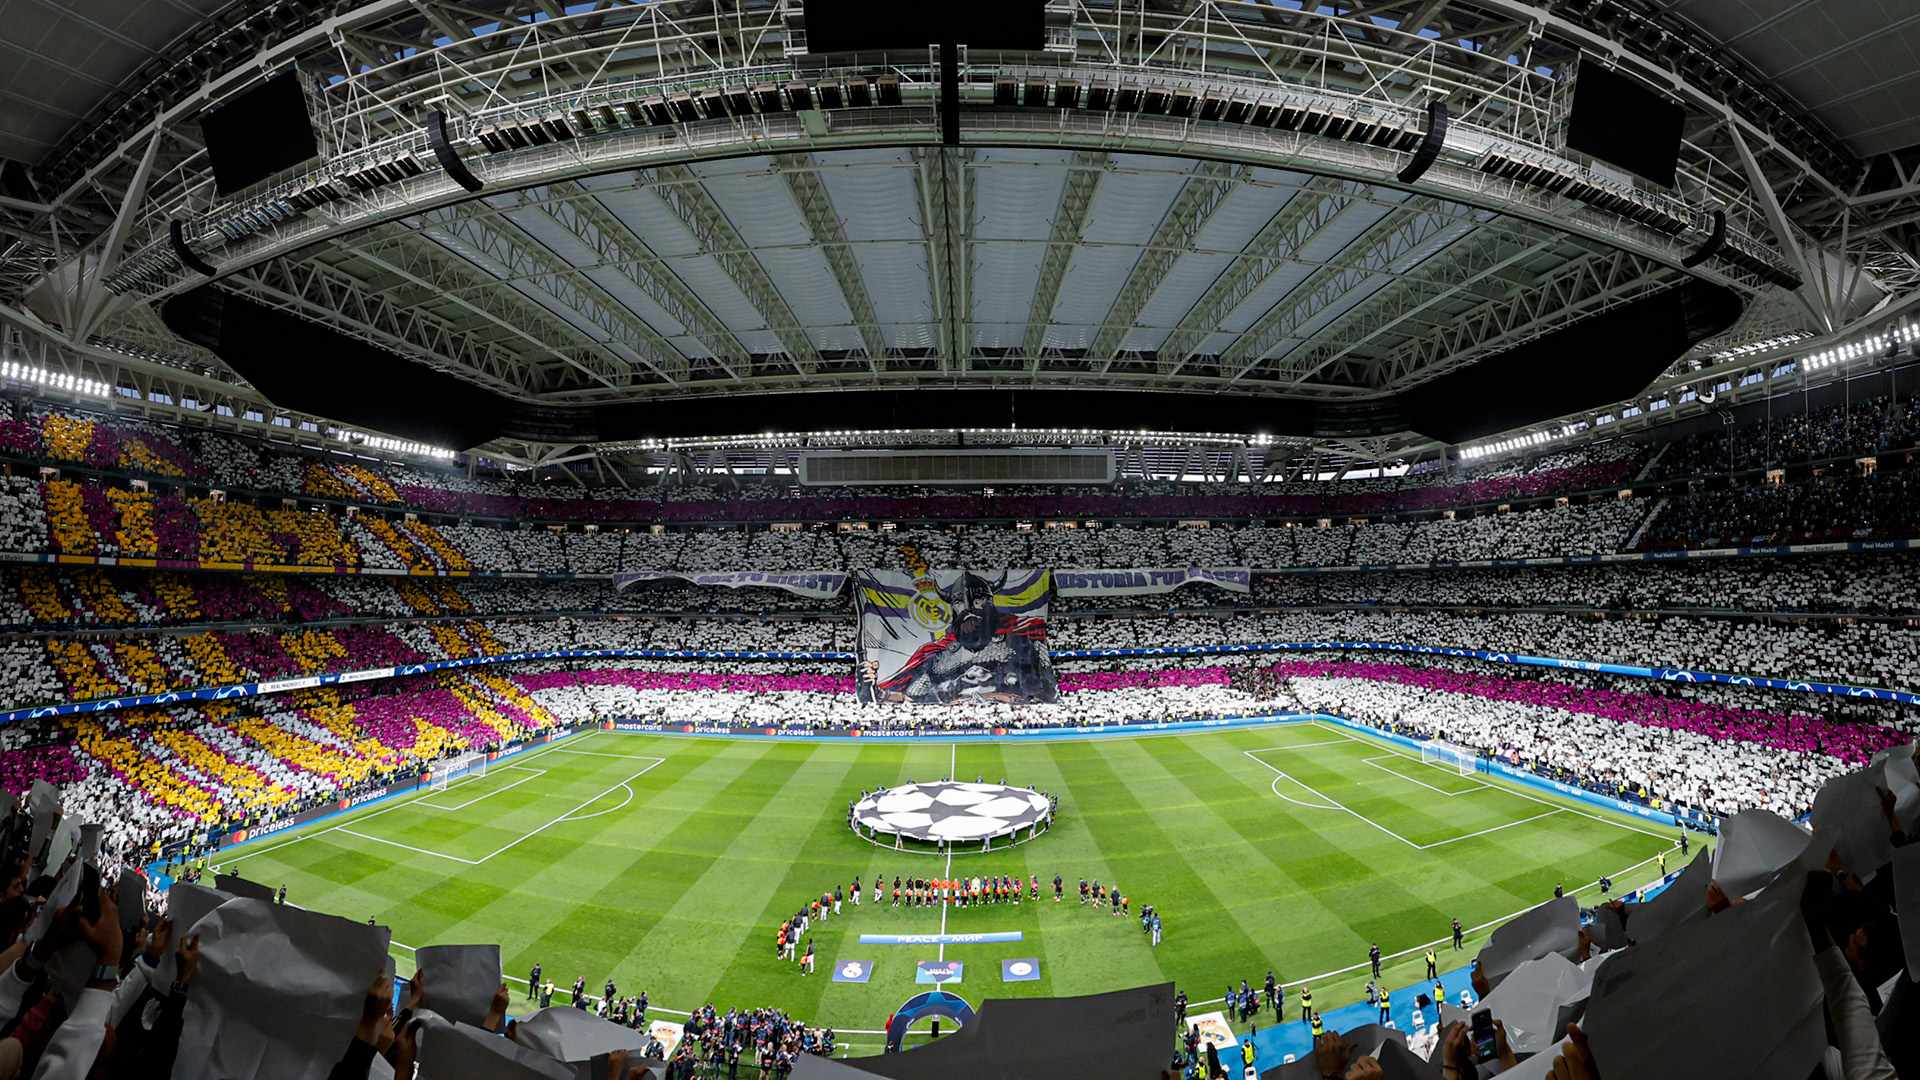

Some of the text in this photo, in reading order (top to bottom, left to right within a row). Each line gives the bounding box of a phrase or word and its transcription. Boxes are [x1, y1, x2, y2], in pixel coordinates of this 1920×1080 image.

[616, 722, 662, 731] mastercard
[695, 726, 730, 734] priceless
[777, 728, 814, 736] priceless
[863, 729, 914, 737] mastercard
[352, 787, 387, 806] priceless
[248, 817, 295, 840] priceless
[897, 935, 939, 943] PEACE
